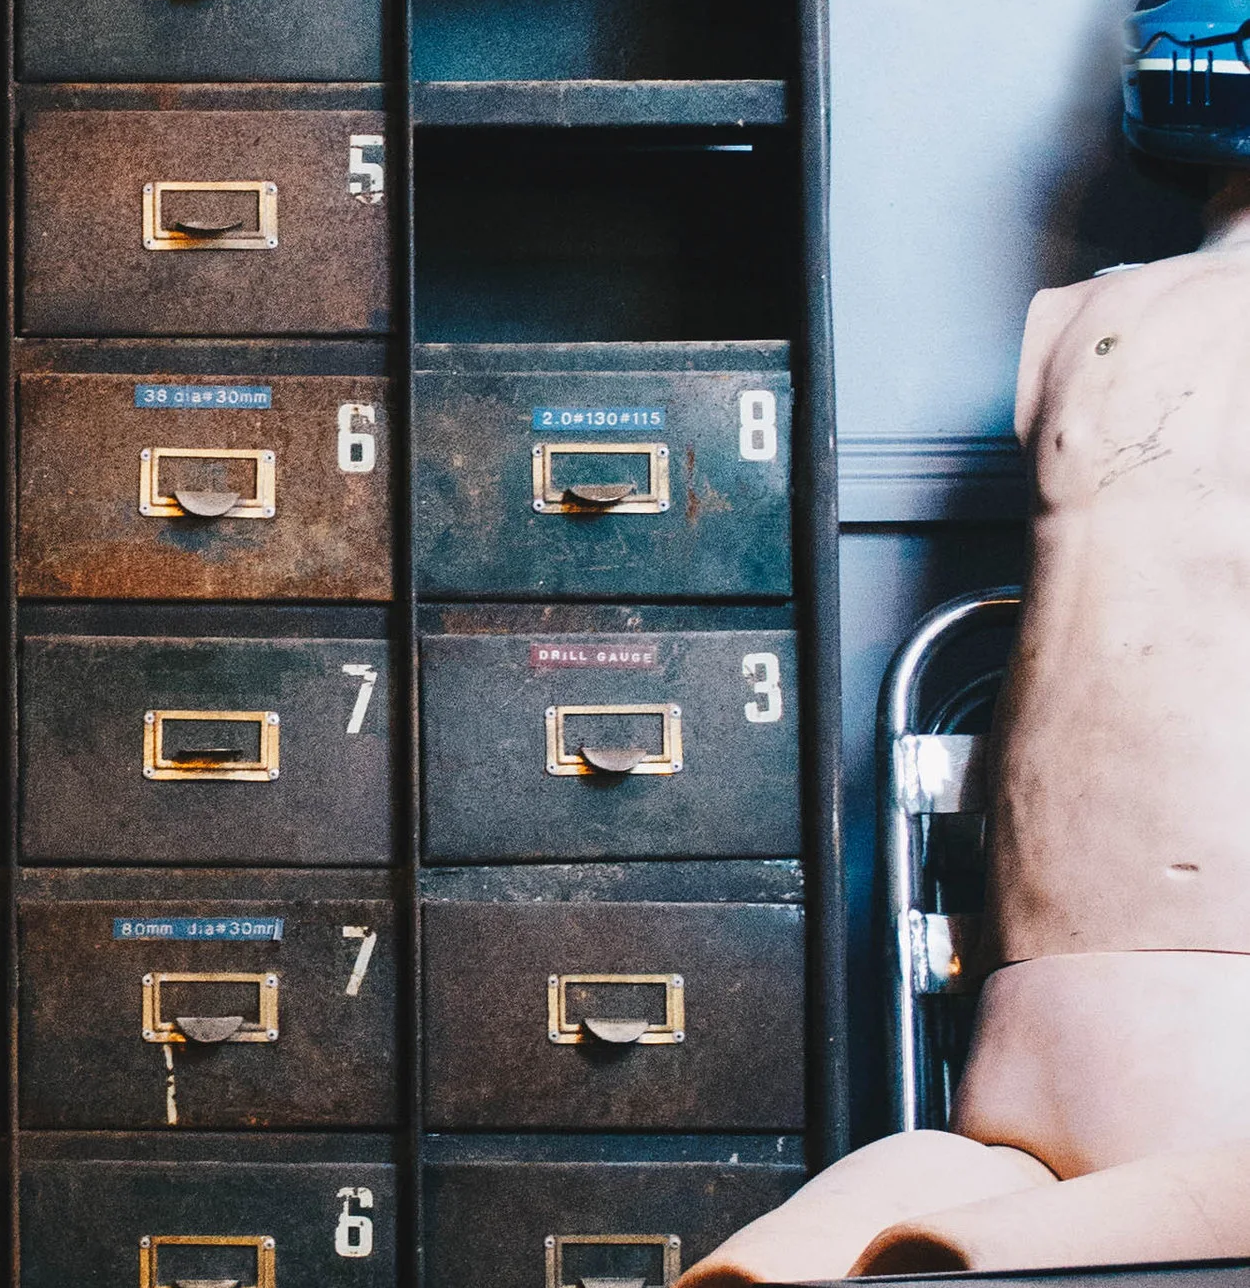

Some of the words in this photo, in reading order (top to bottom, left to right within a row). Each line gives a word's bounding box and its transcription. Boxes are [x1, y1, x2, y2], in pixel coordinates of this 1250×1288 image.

[349, 135, 383, 203] 5
[144, 390, 168, 403] 38
[542, 411, 661, 426] 2.0#130#115
[740, 390, 777, 461] 8
[338, 404, 375, 473] 6
[538, 650, 588, 662] DRILL
[596, 651, 653, 664] GAUGE
[742, 653, 782, 722] 3
[343, 665, 377, 733] 7
[120, 922, 174, 937] 80mm
[343, 926, 376, 995] 7
[335, 1187, 373, 1257] 6
